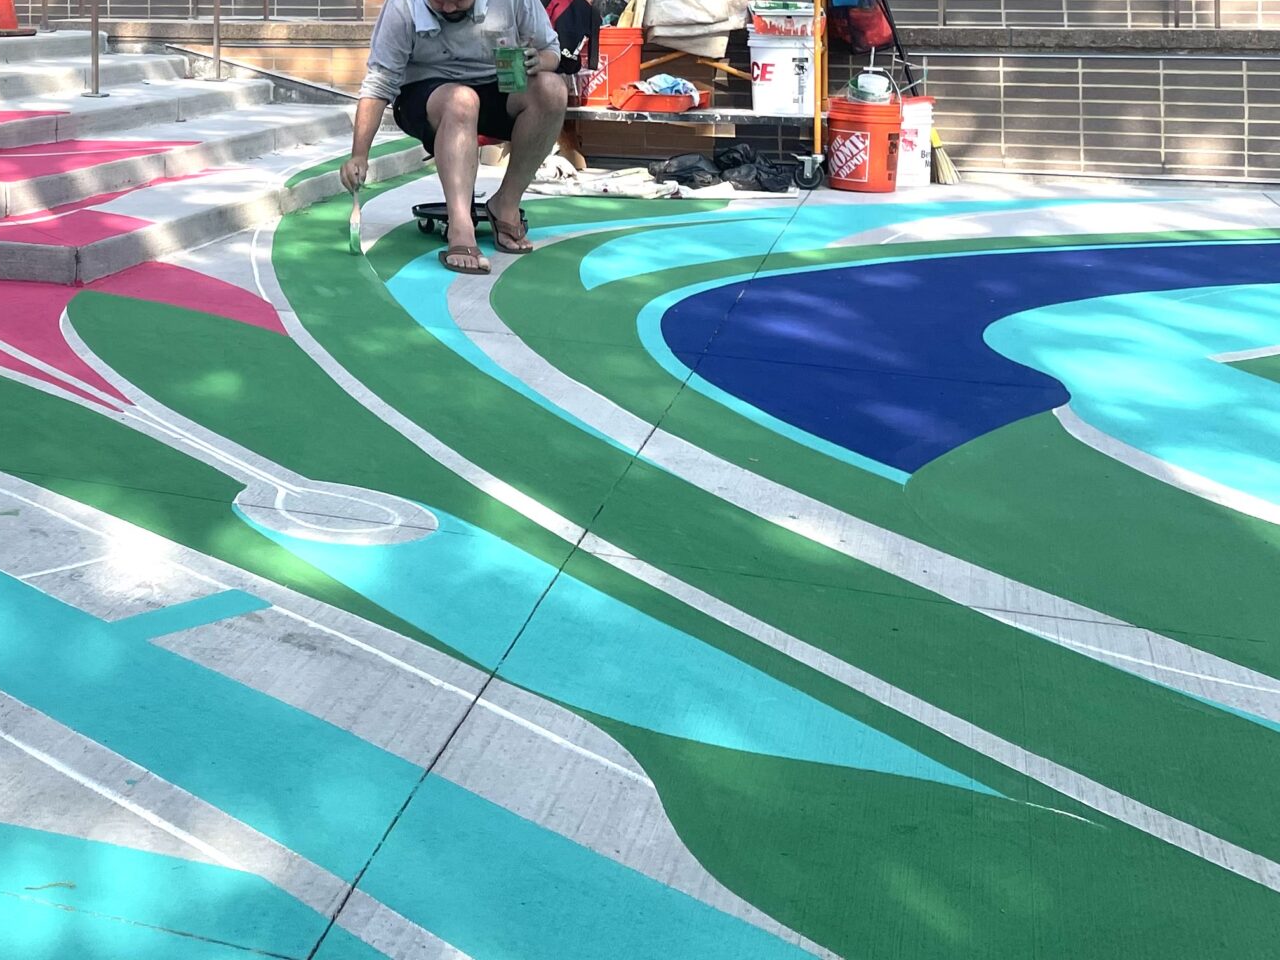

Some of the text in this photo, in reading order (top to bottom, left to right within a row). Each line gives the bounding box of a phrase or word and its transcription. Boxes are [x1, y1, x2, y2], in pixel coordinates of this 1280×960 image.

[828, 132, 868, 177] HOME
[831, 135, 844, 153] THE
[839, 150, 868, 179] DEPOT
